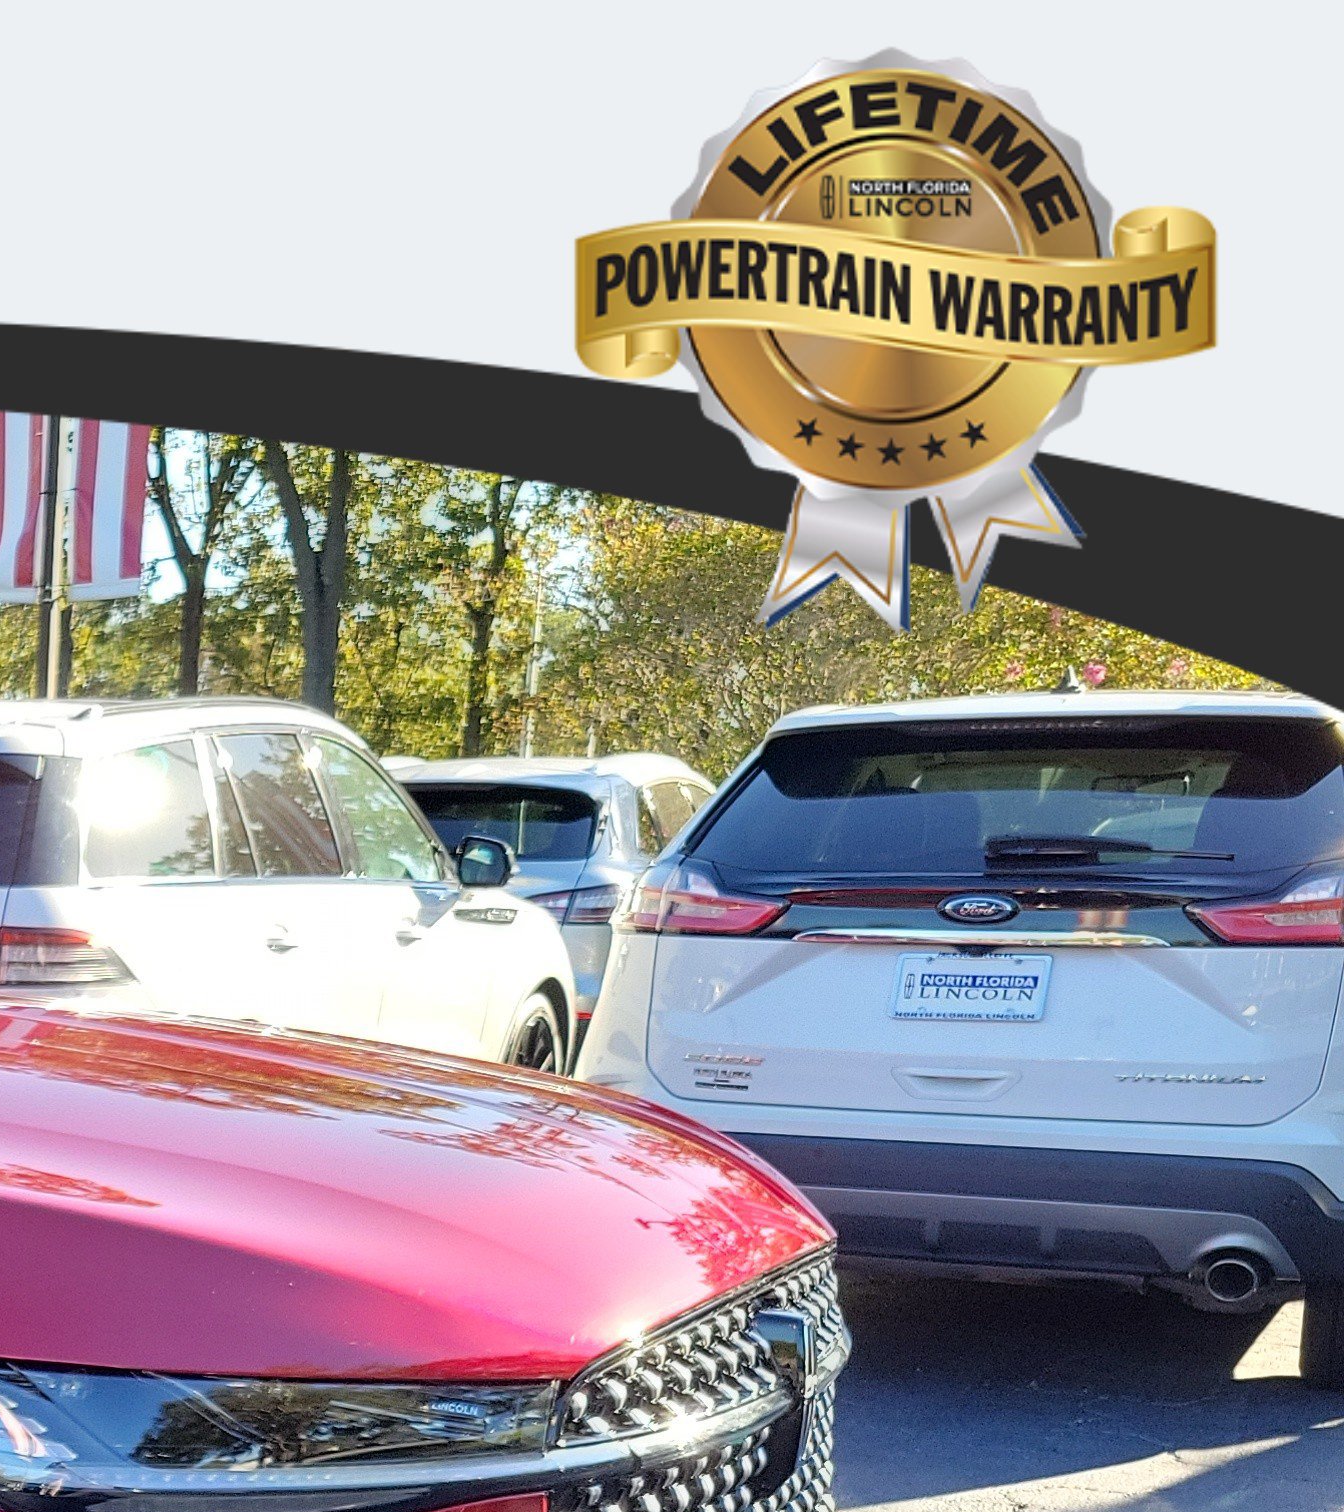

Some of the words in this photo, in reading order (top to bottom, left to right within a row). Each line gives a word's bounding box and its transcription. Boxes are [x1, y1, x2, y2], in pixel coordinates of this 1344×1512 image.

[923, 975, 972, 987] NORTH
[976, 976, 1035, 988] FLORIDA
[918, 987, 1034, 1001] LINCOLN
[431, 1402, 479, 1416] LINCOLN
